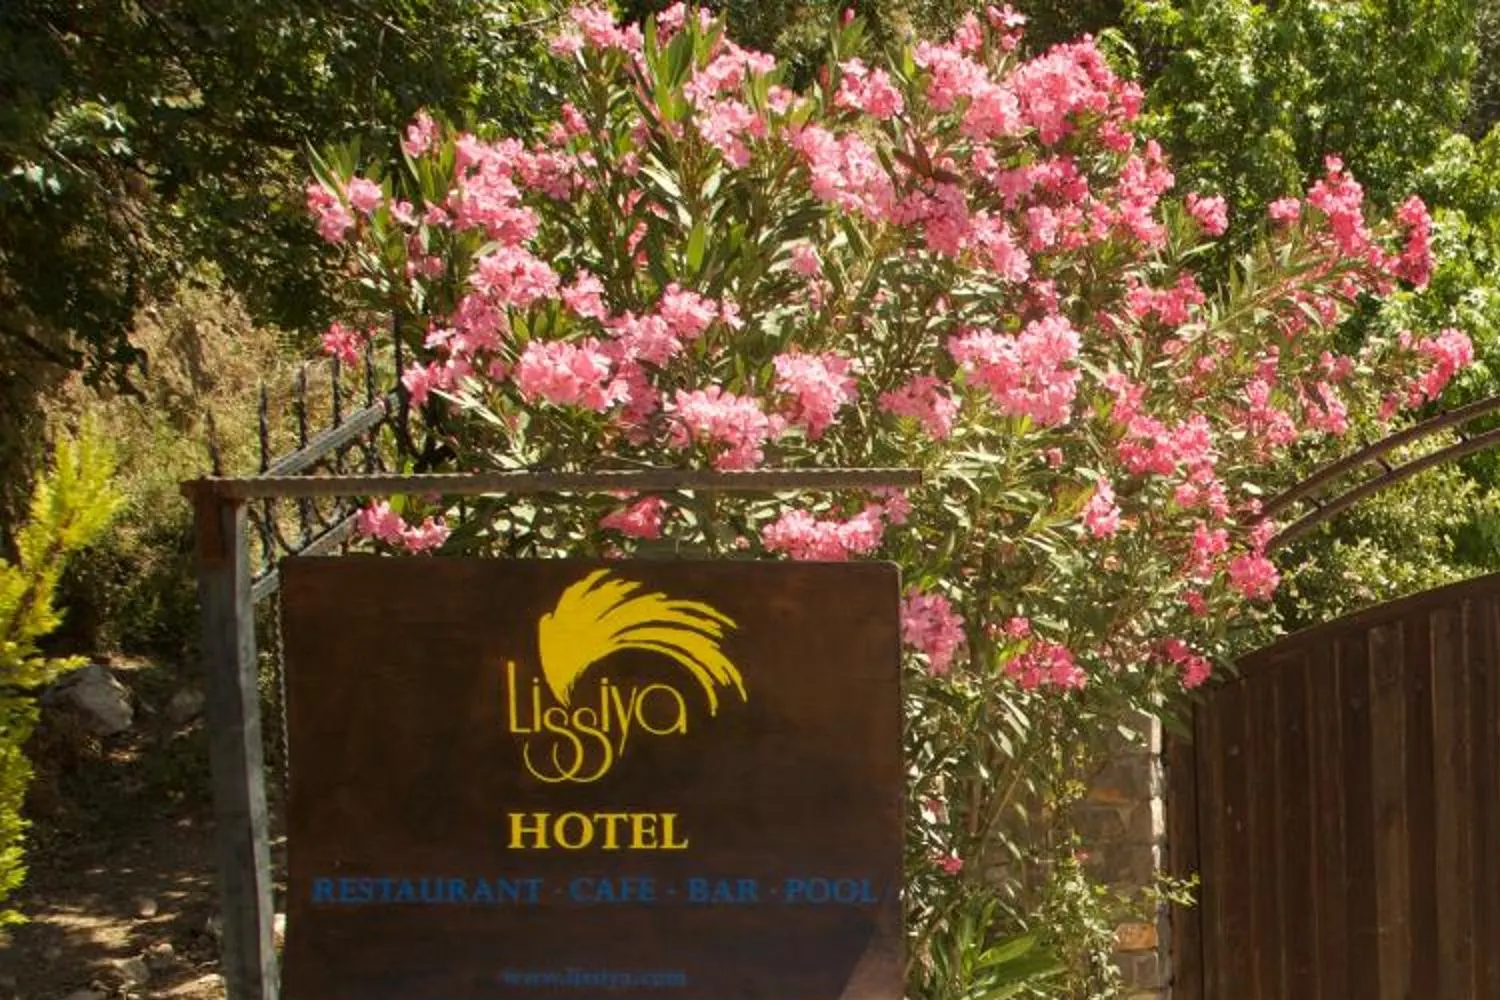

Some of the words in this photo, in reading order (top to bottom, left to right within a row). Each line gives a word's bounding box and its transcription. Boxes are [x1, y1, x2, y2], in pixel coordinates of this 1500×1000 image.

[508, 660, 688, 782] Lissiya
[508, 812, 689, 849] HOTEL
[312, 877, 543, 904] RESTAURANT
[689, 878, 757, 903] BAR
[785, 877, 878, 904] POOL
